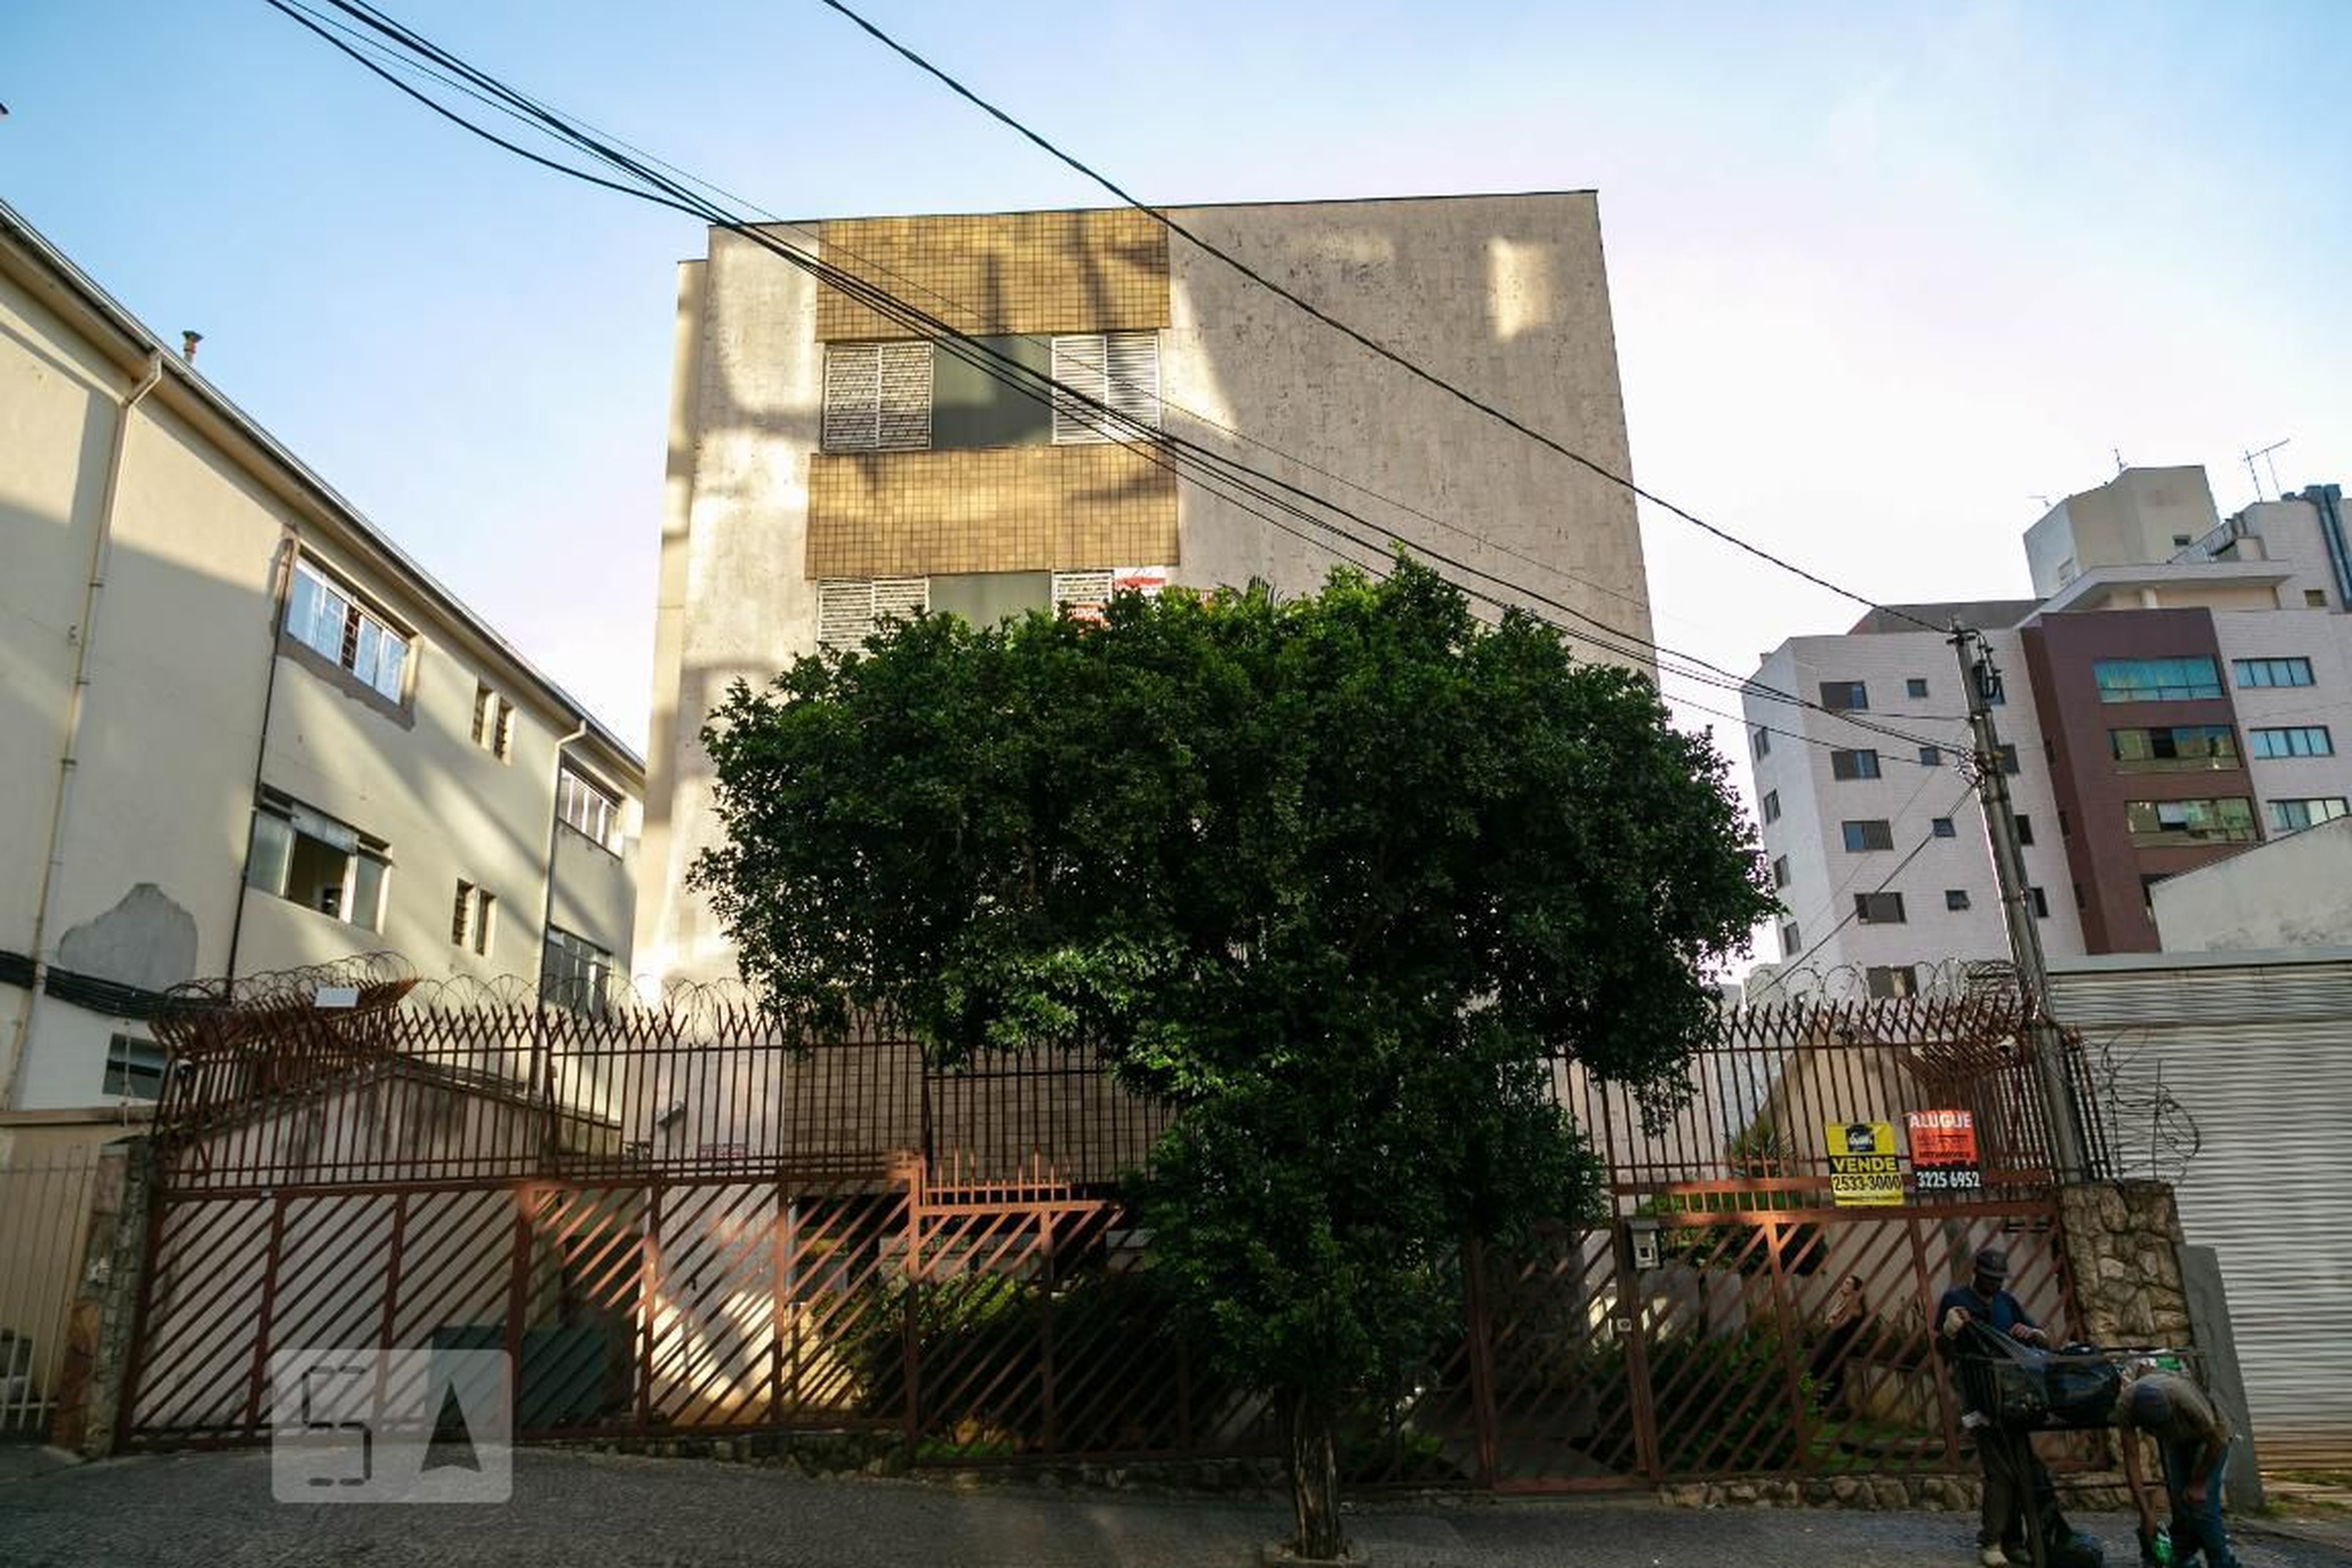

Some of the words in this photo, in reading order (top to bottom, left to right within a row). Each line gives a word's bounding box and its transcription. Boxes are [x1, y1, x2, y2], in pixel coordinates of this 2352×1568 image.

[1910, 1113, 1972, 1128] ALUGUE
[1831, 1157, 1897, 1172] VENDE
[1917, 1171, 1947, 1188] 3225
[1950, 1171, 1981, 1188] 6952
